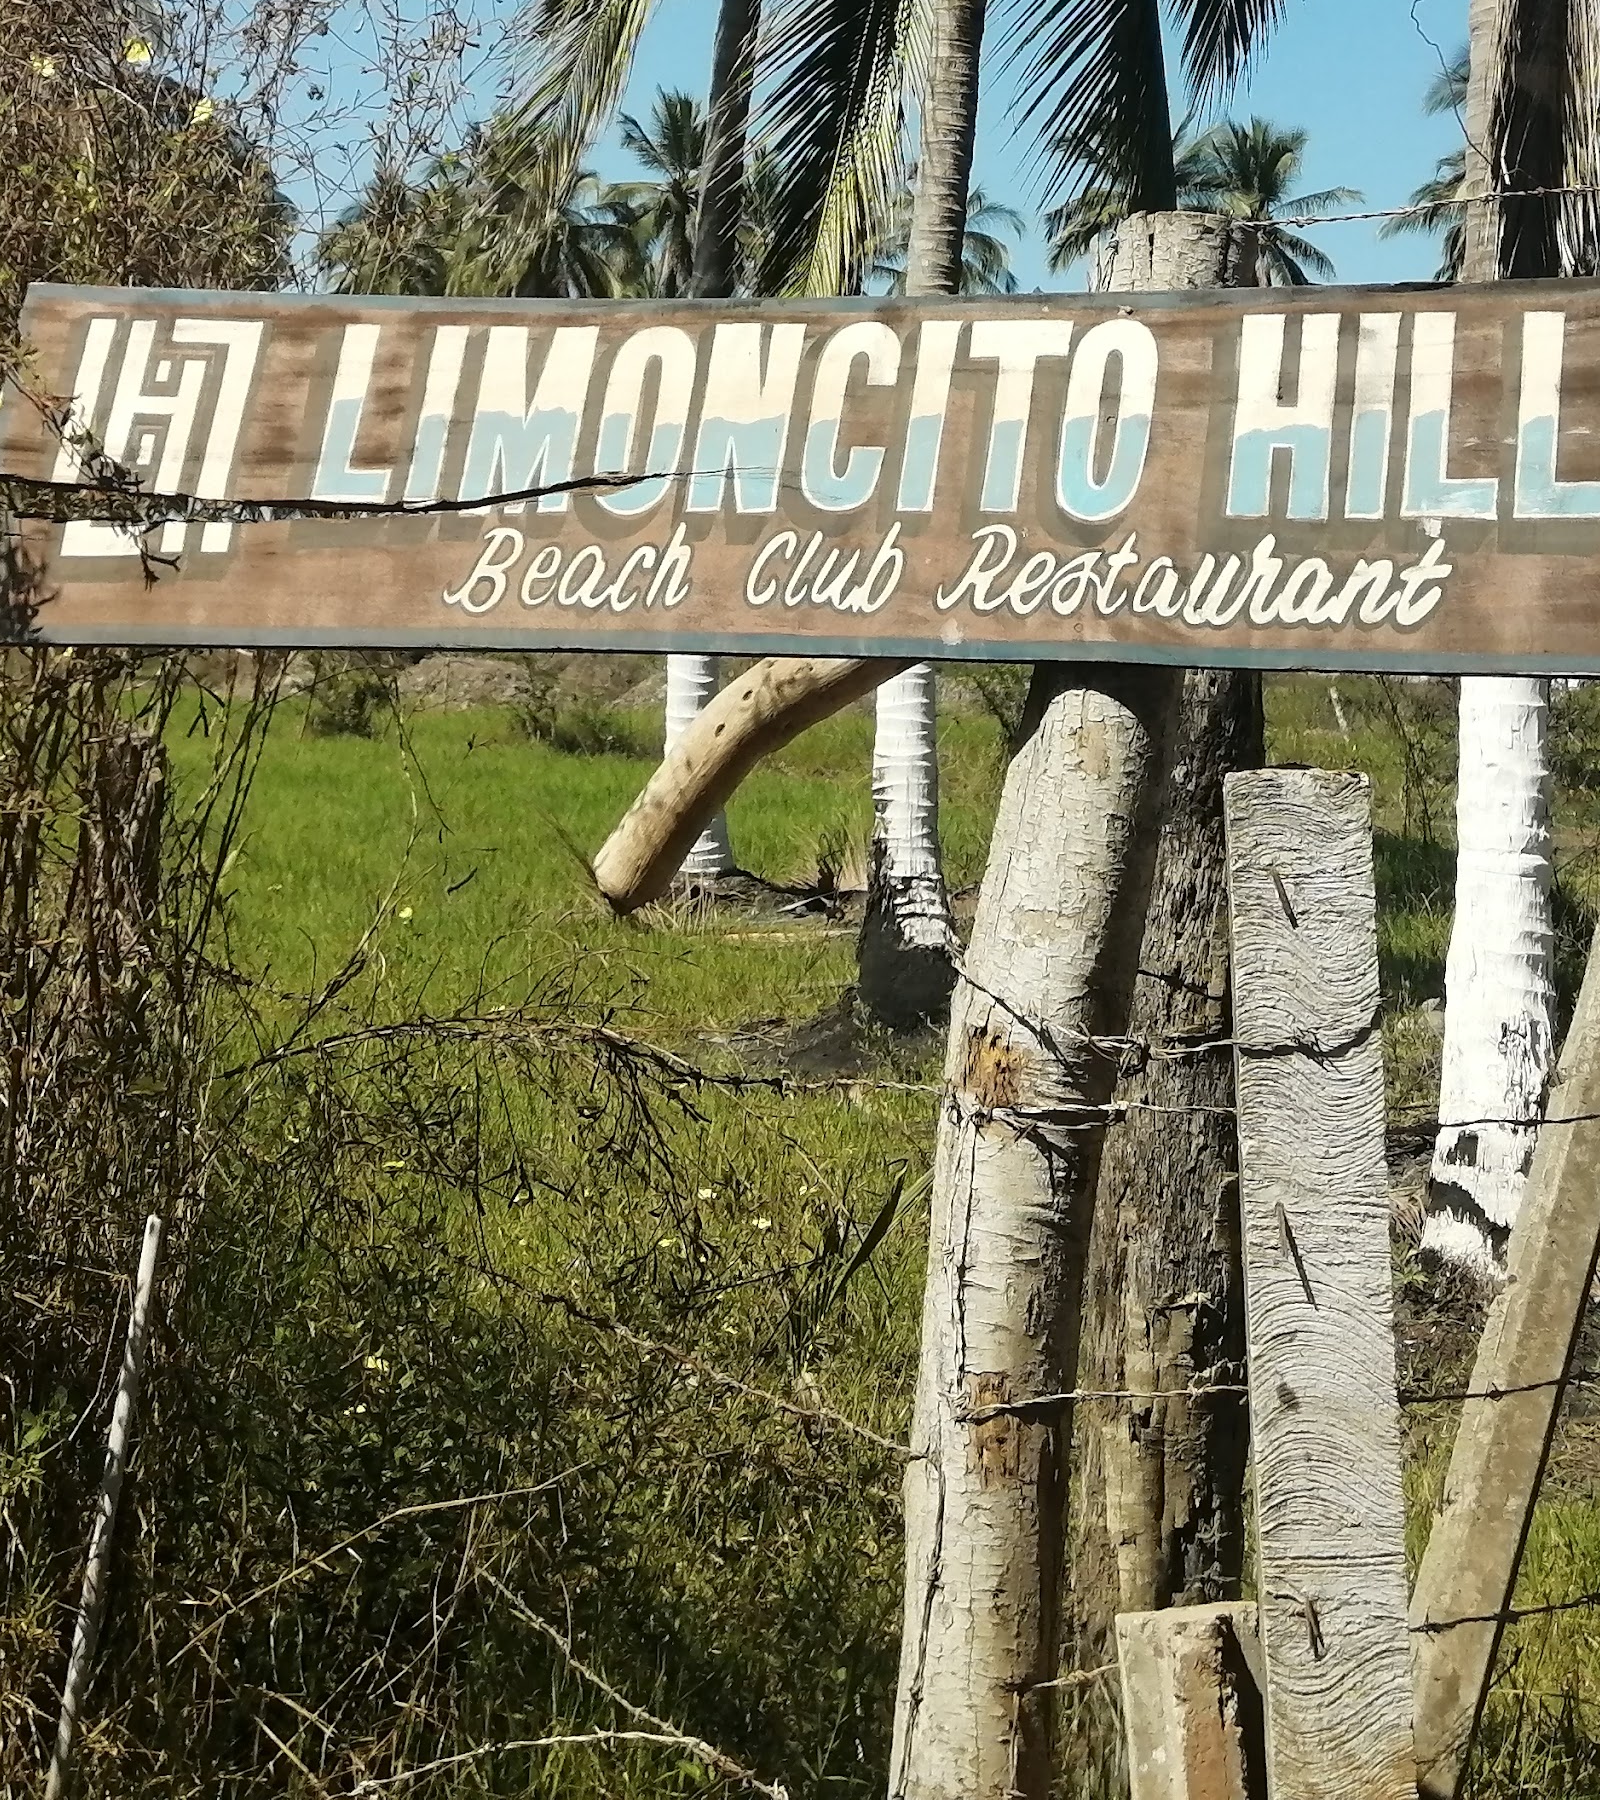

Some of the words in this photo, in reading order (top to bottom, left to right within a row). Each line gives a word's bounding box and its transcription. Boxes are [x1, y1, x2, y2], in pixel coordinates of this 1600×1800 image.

[311, 317, 1159, 523] LIMONCITO
[442, 522, 693, 613] Beach
[746, 521, 905, 614] Club
[937, 524, 1454, 627] Restaurant
